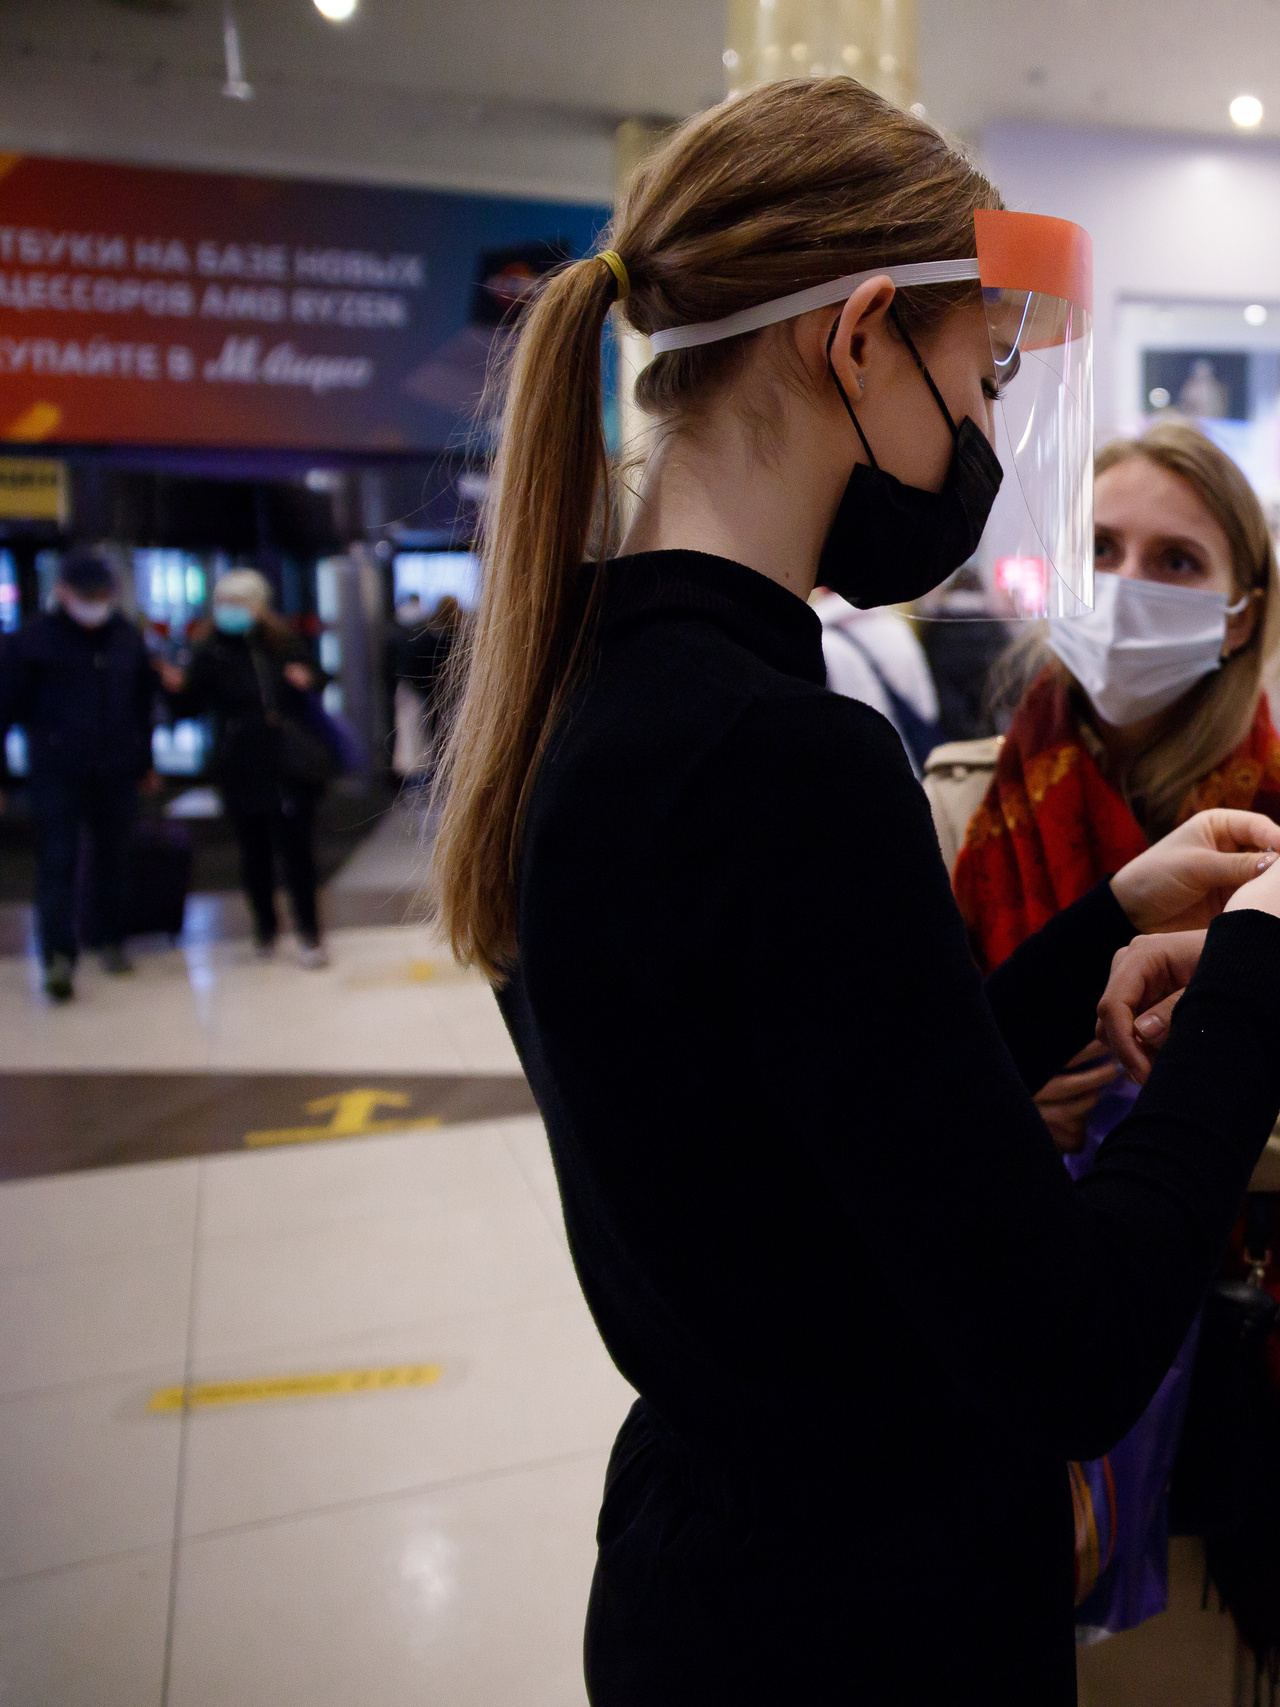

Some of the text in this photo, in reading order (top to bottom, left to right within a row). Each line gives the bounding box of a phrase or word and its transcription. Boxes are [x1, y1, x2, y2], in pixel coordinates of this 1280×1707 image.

[133, 235, 191, 272] НА
[196, 240, 287, 278] БАЗЕ
[295, 247, 424, 288] НОВЫХ
[200, 283, 287, 322] AMD
[292, 287, 407, 328] RYZEN
[168, 344, 196, 383] В
